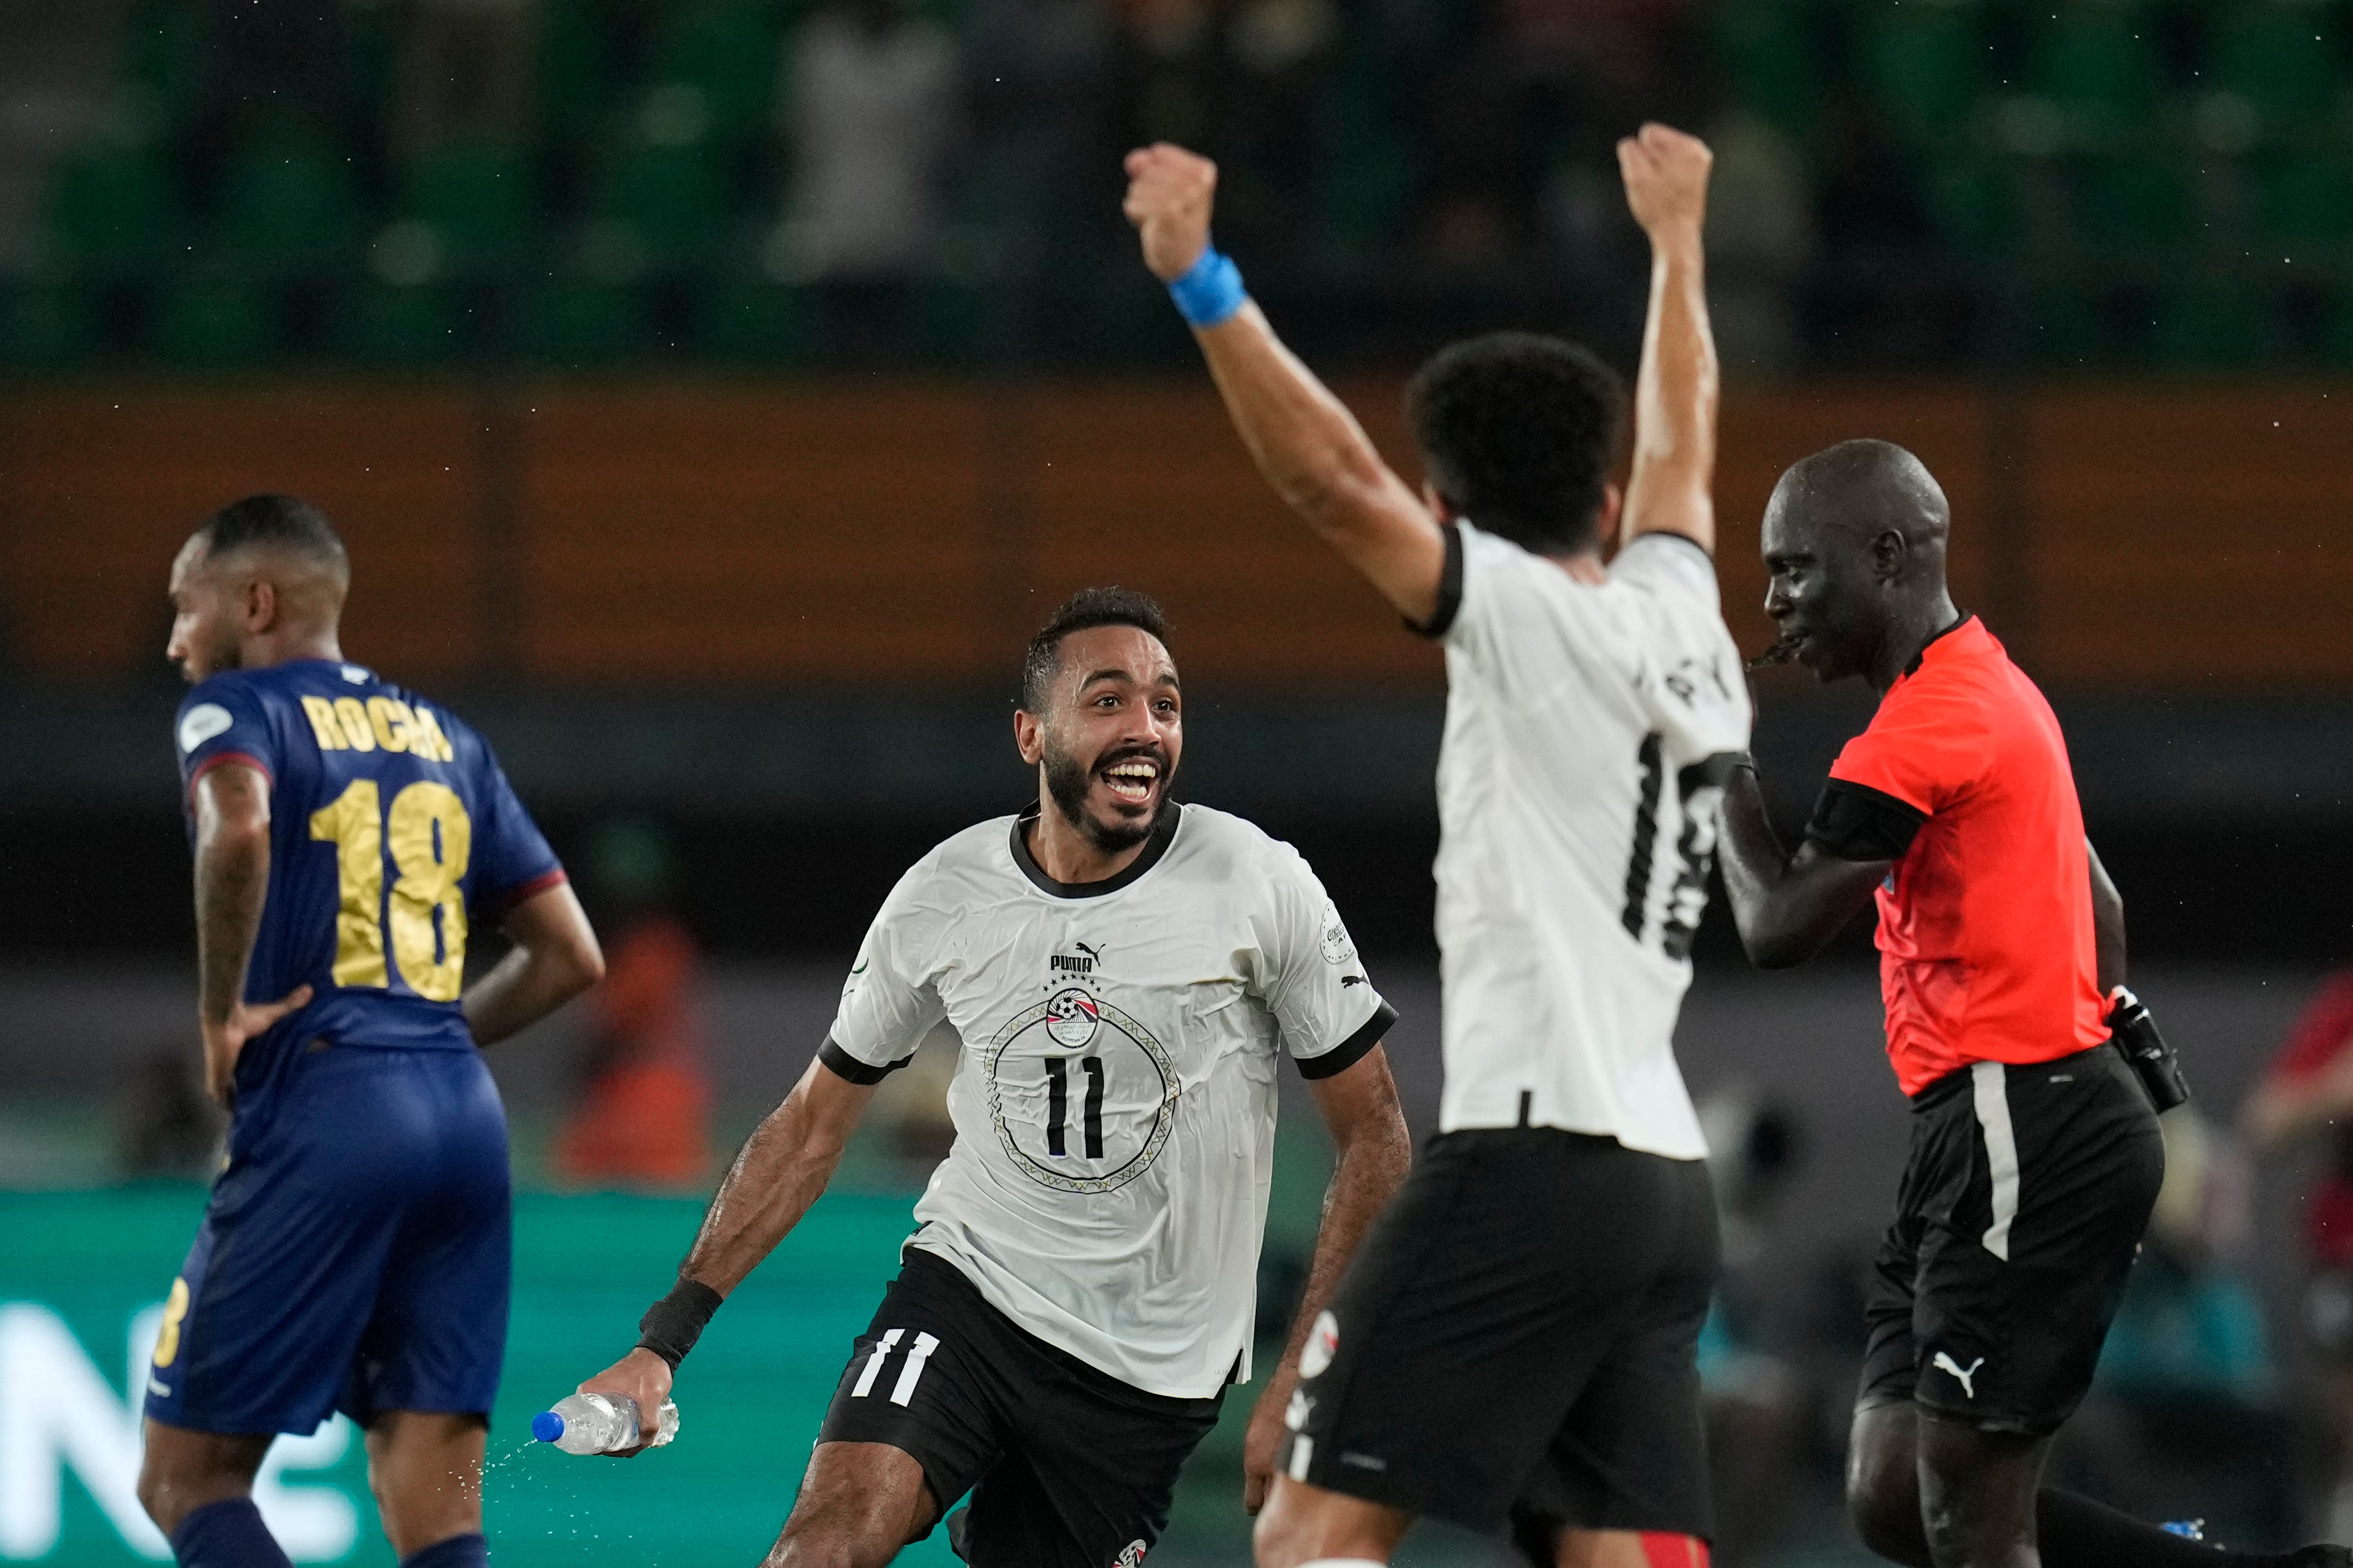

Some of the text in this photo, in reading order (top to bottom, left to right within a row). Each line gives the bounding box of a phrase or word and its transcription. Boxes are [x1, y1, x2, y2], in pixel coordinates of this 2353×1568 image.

[310, 778, 471, 1002] 18
[1050, 955, 1092, 972] PUMA
[1044, 1056, 1104, 1159] 11
[851, 1329, 940, 1407] 11
